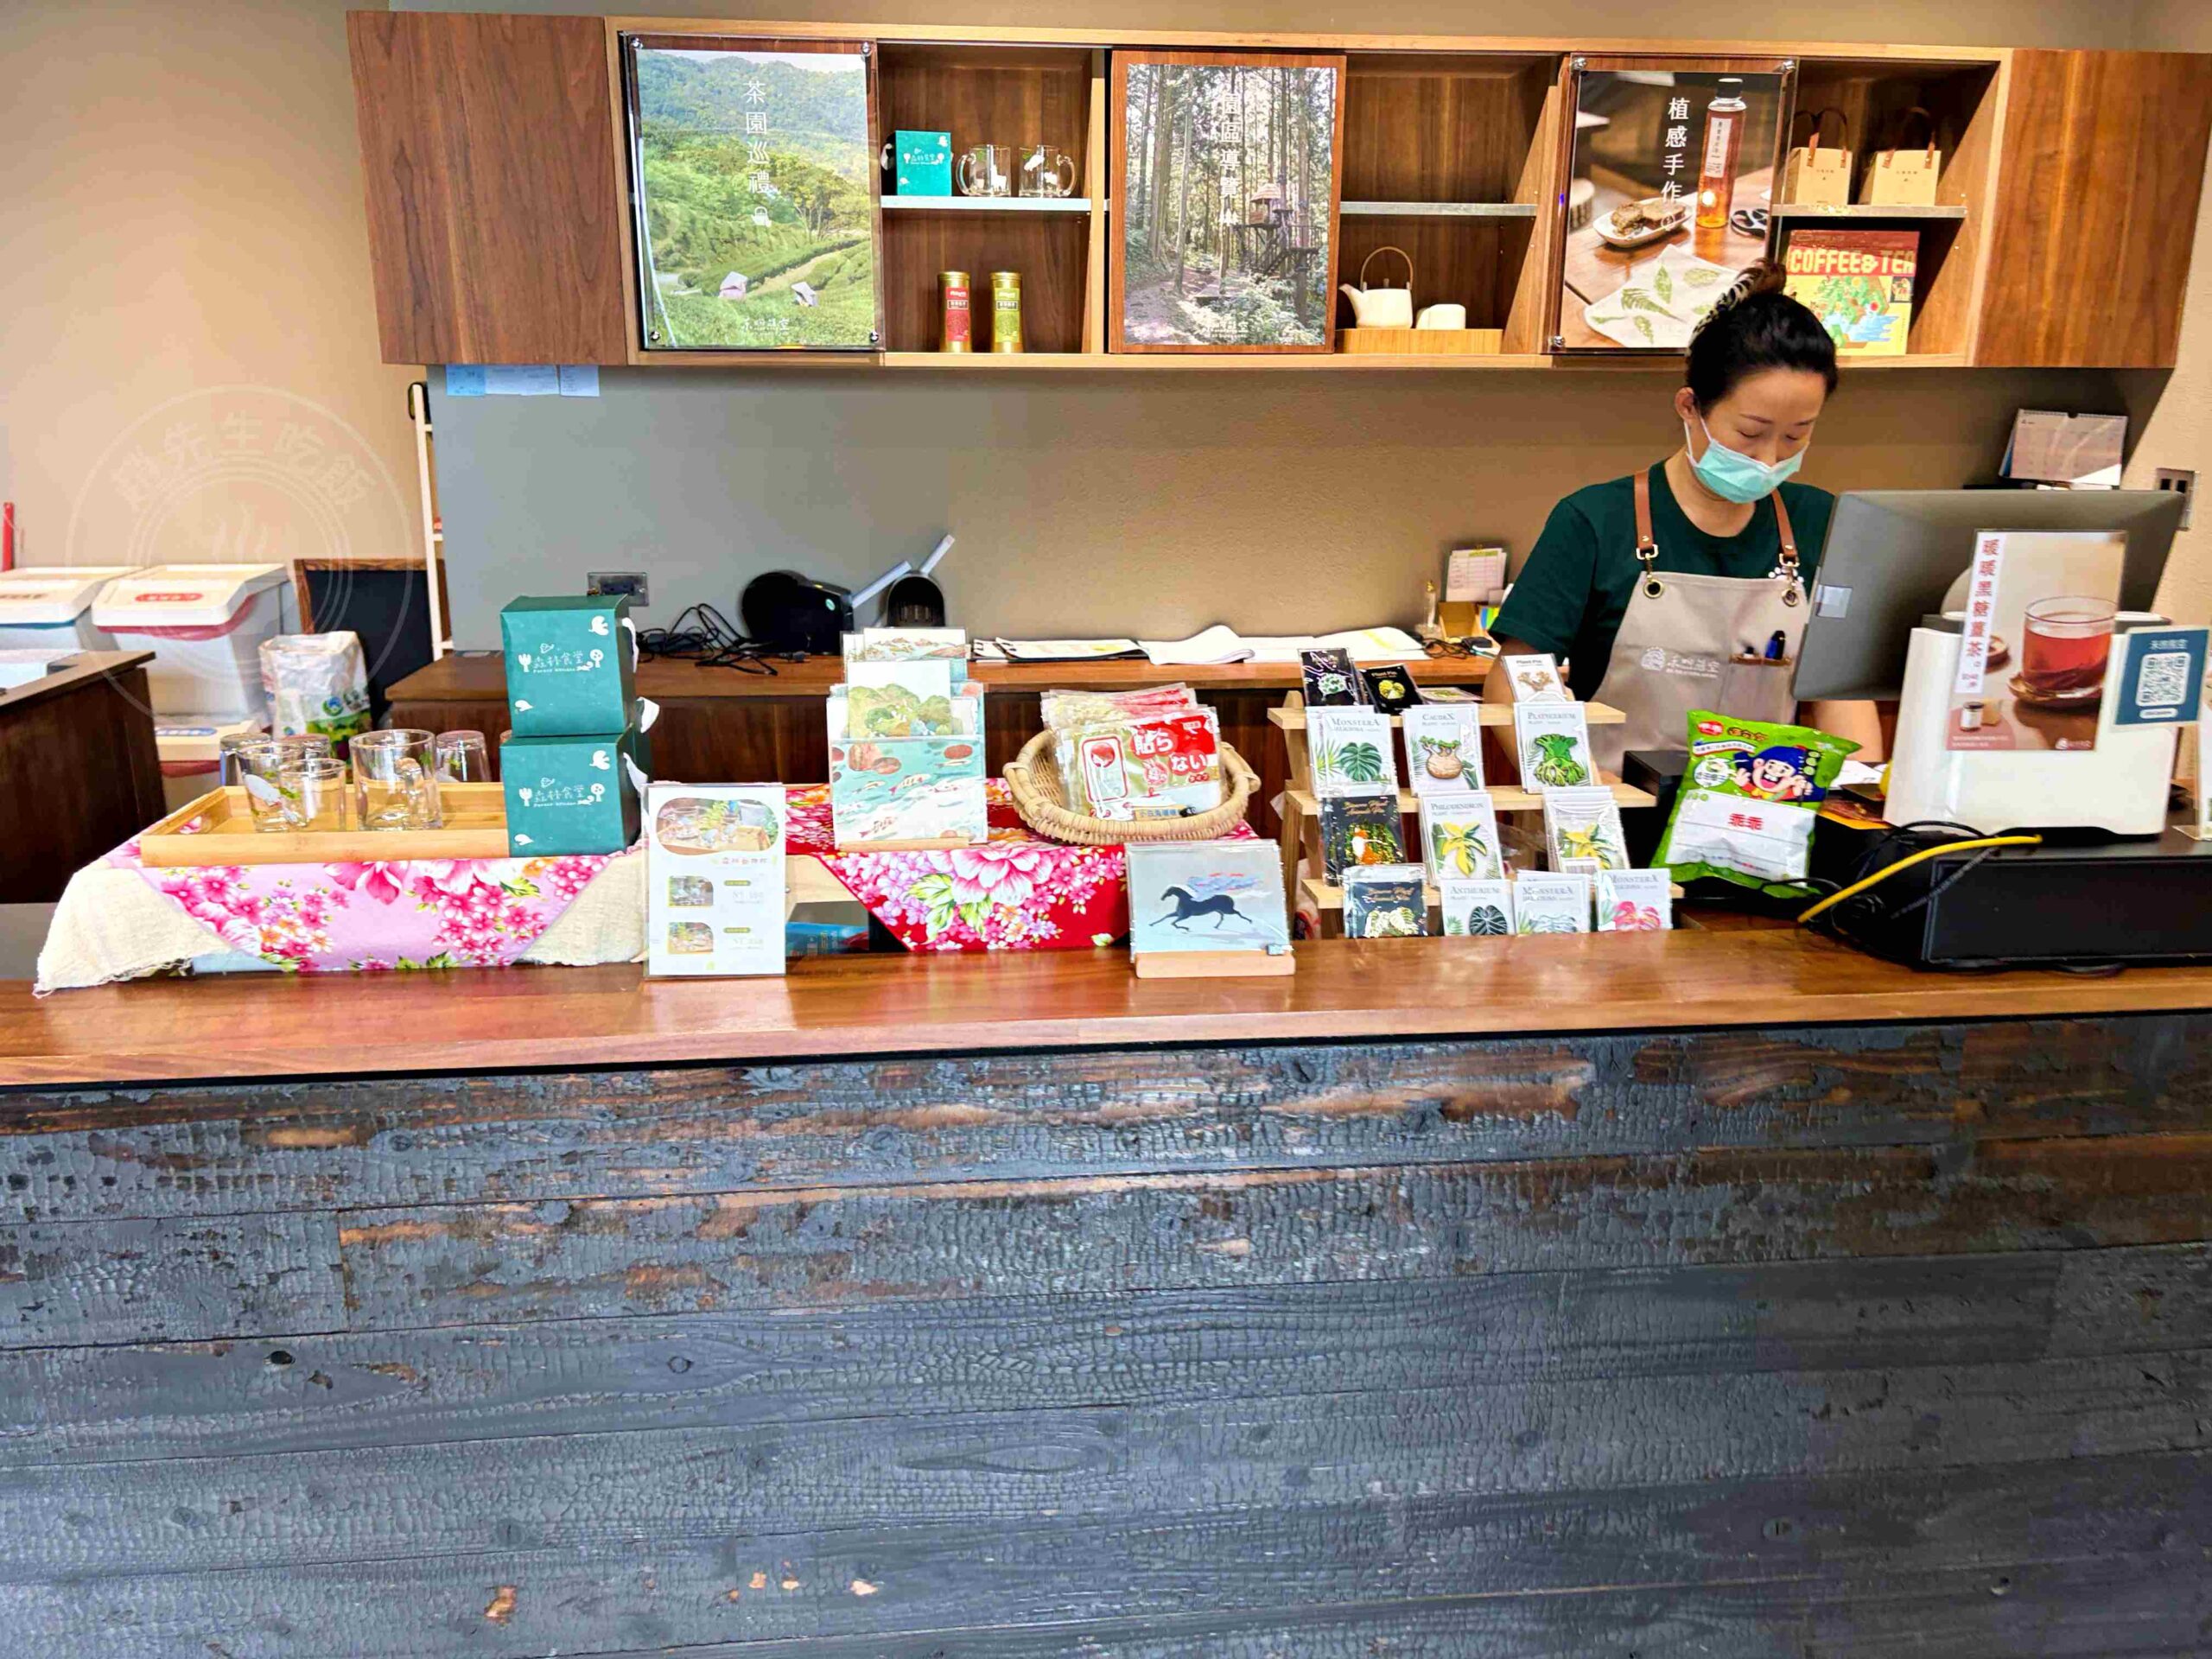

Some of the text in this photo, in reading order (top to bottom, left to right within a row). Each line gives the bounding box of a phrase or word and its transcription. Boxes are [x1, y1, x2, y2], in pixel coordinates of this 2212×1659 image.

[741, 80, 771, 194] 茶園巡禮
[1219, 92, 1242, 198] 園區導覽
[1661, 97, 1690, 204] 植感手作
[1728, 813, 1763, 830] 乖乖
